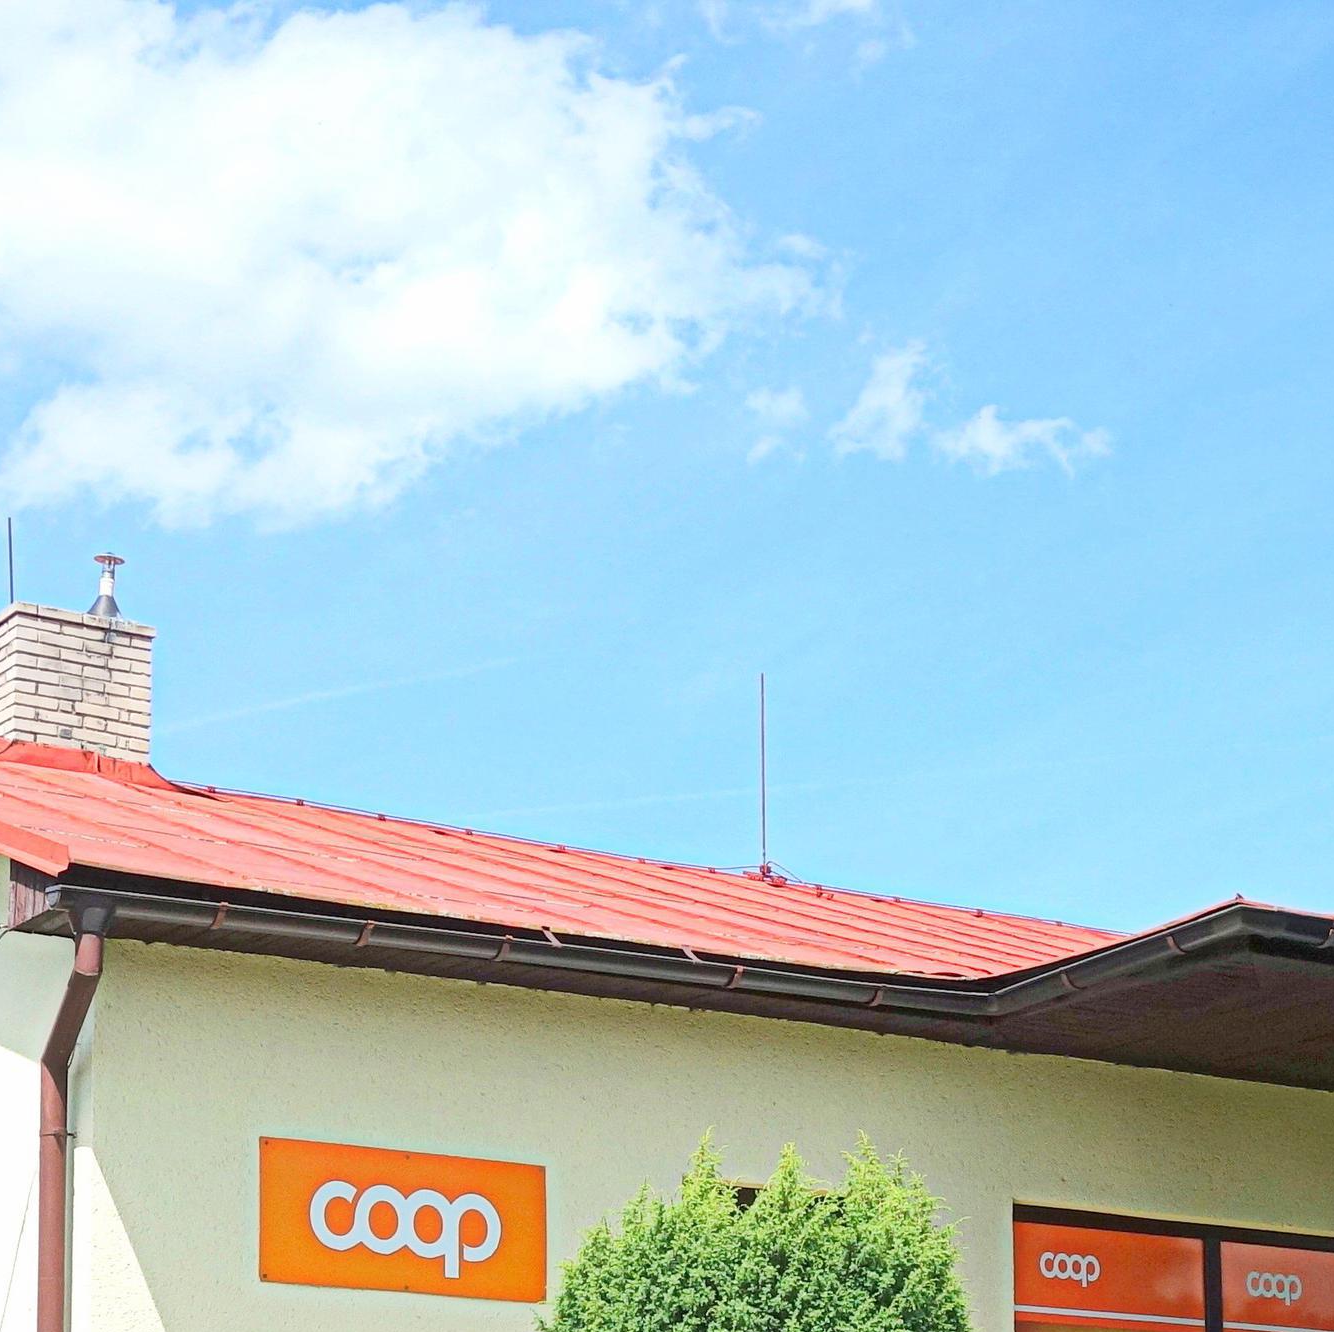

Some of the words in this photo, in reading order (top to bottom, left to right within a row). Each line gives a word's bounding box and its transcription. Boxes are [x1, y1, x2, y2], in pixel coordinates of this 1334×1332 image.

[309, 1180, 503, 1279] coop
[1039, 1251, 1101, 1288] coop
[1246, 1270, 1303, 1306] coop
